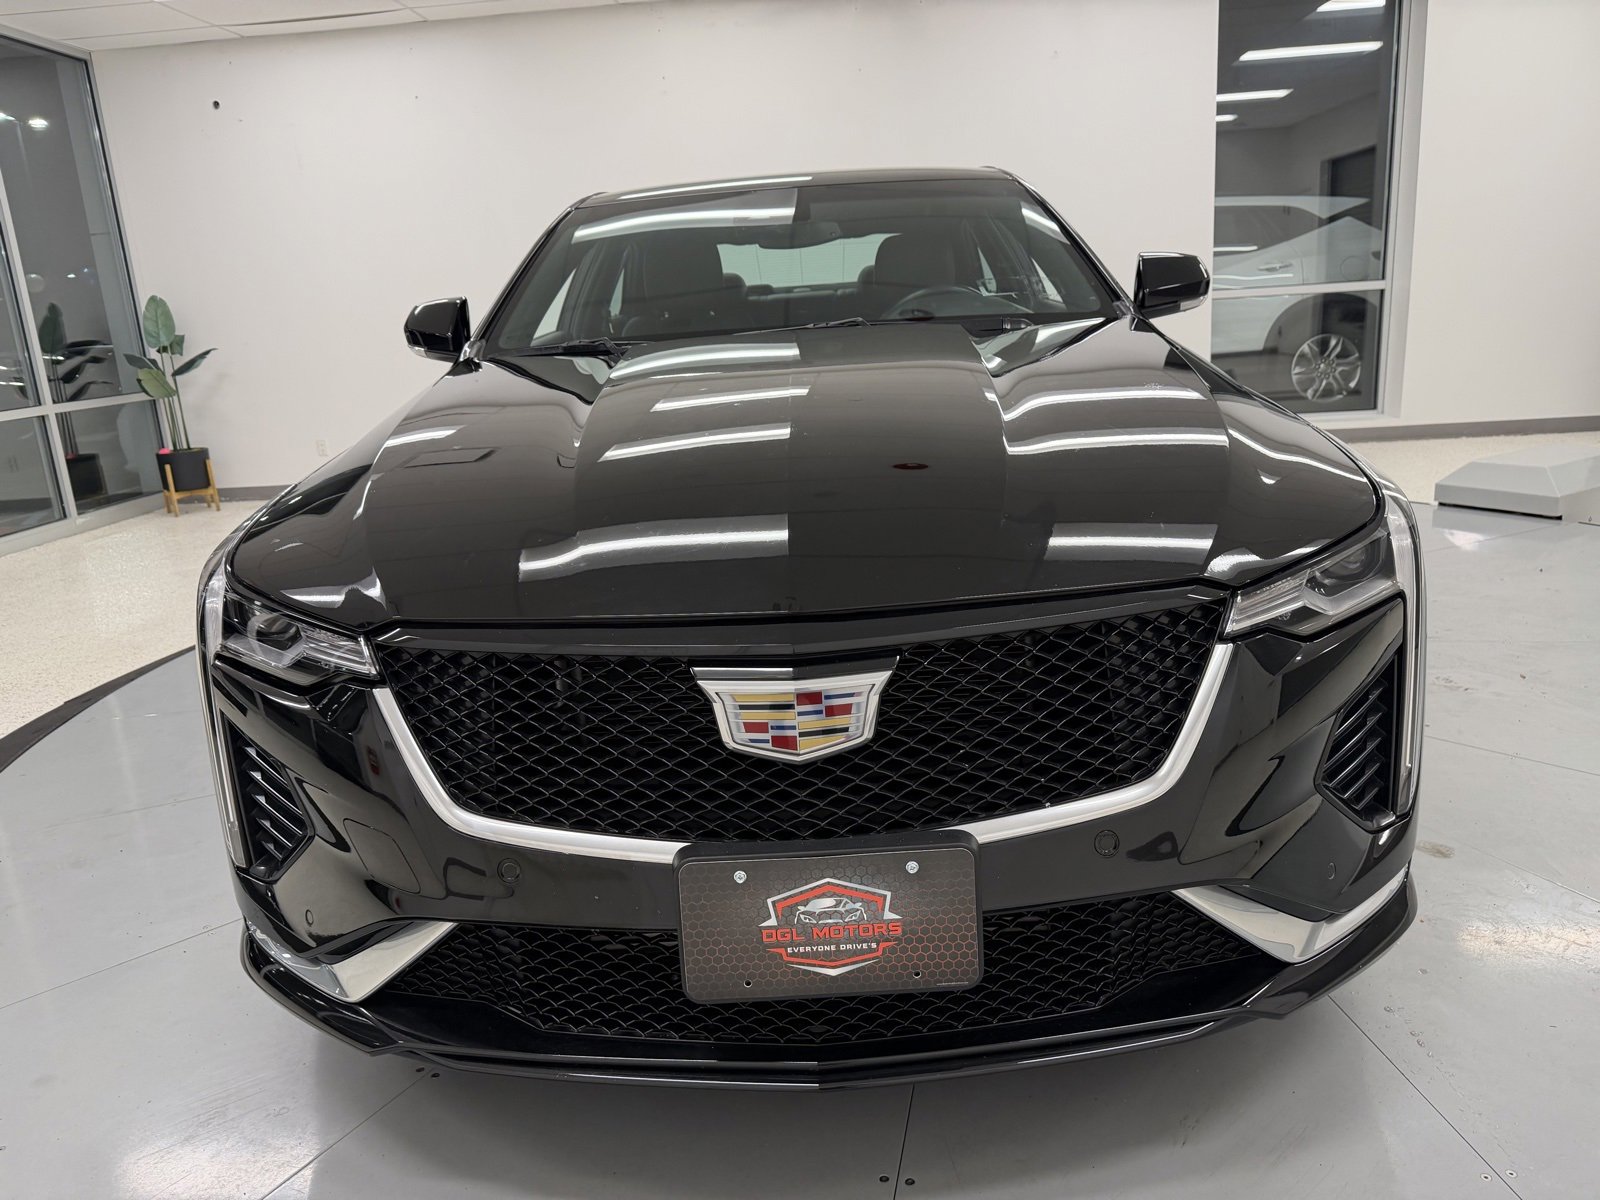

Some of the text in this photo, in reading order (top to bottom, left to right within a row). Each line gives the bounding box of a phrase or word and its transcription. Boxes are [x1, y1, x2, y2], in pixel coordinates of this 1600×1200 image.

[811, 921, 903, 941] MOTORS
[787, 942, 878, 953] EVERYONE DRIVE'S
